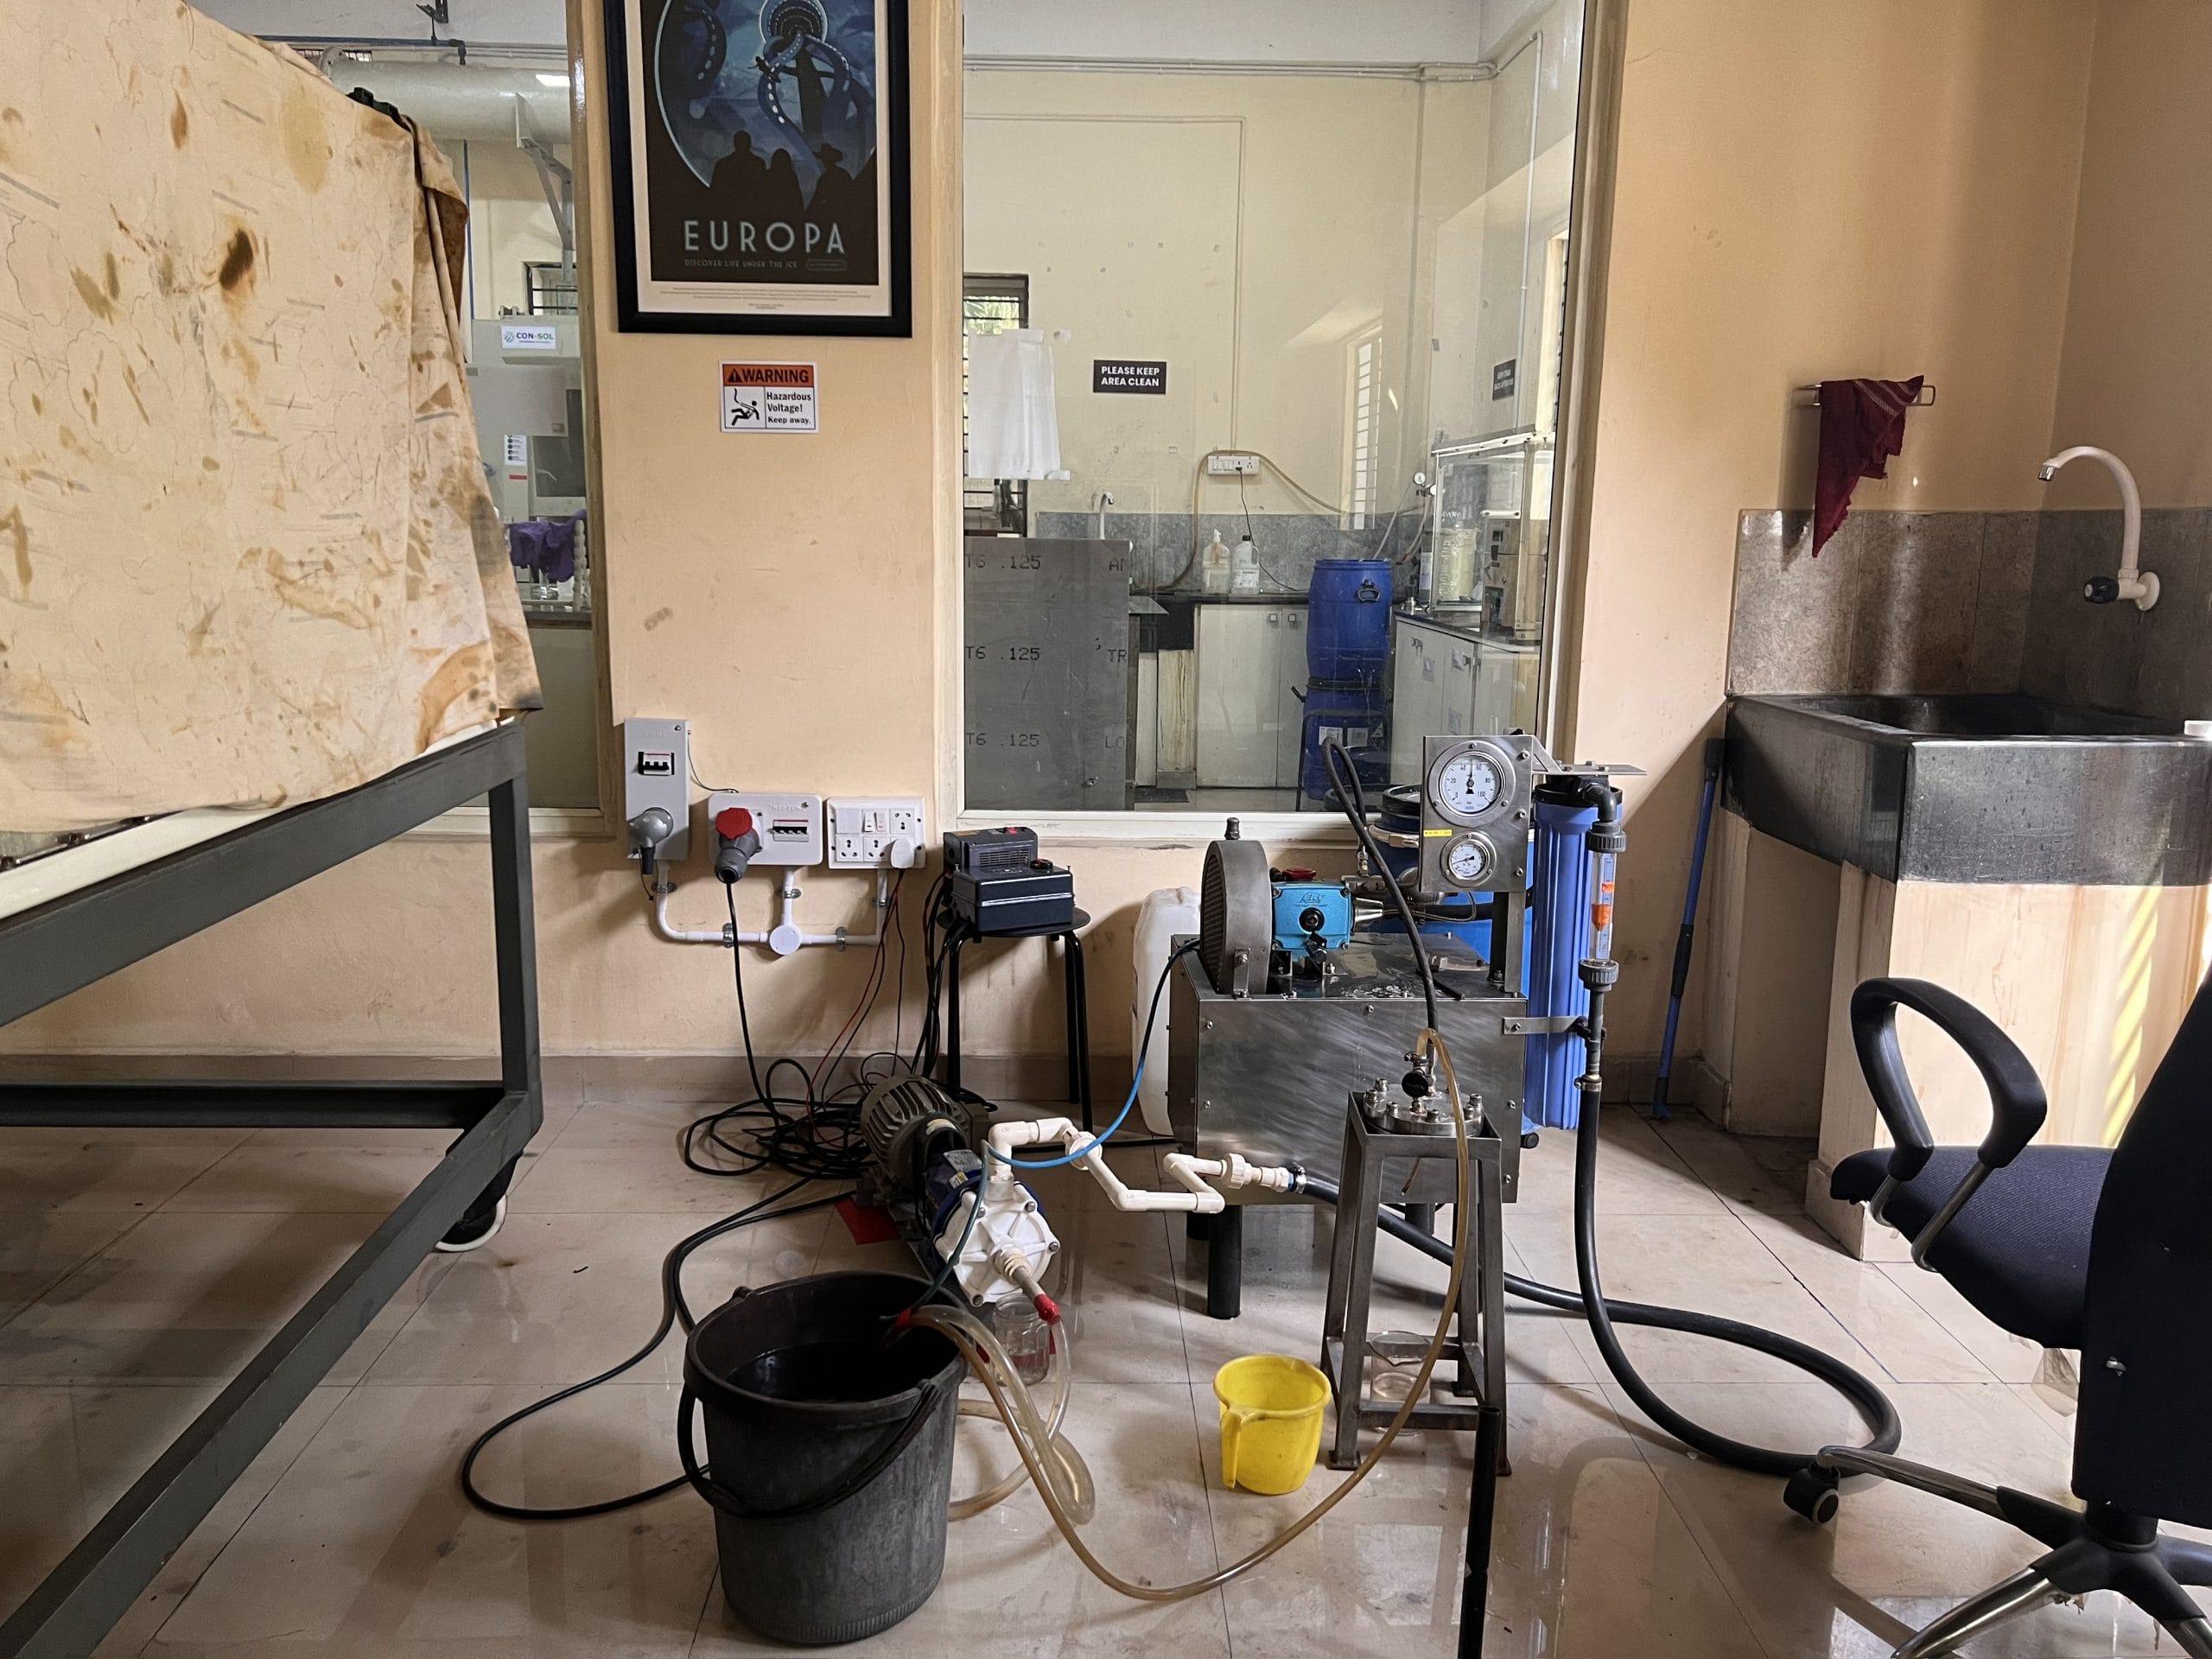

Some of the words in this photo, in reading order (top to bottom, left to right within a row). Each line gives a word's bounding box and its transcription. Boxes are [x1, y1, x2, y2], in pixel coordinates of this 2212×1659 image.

[684, 220, 844, 254] EUROPA
[725, 259, 740, 268] LIFE
[741, 368, 810, 384] WARNING
[766, 391, 812, 401] Hazardous
[767, 403, 804, 414] Voltage!
[964, 645, 986, 659] T6
[1001, 646, 1040, 660] .125
[965, 732, 986, 746] T6
[1001, 733, 1039, 747] .125
